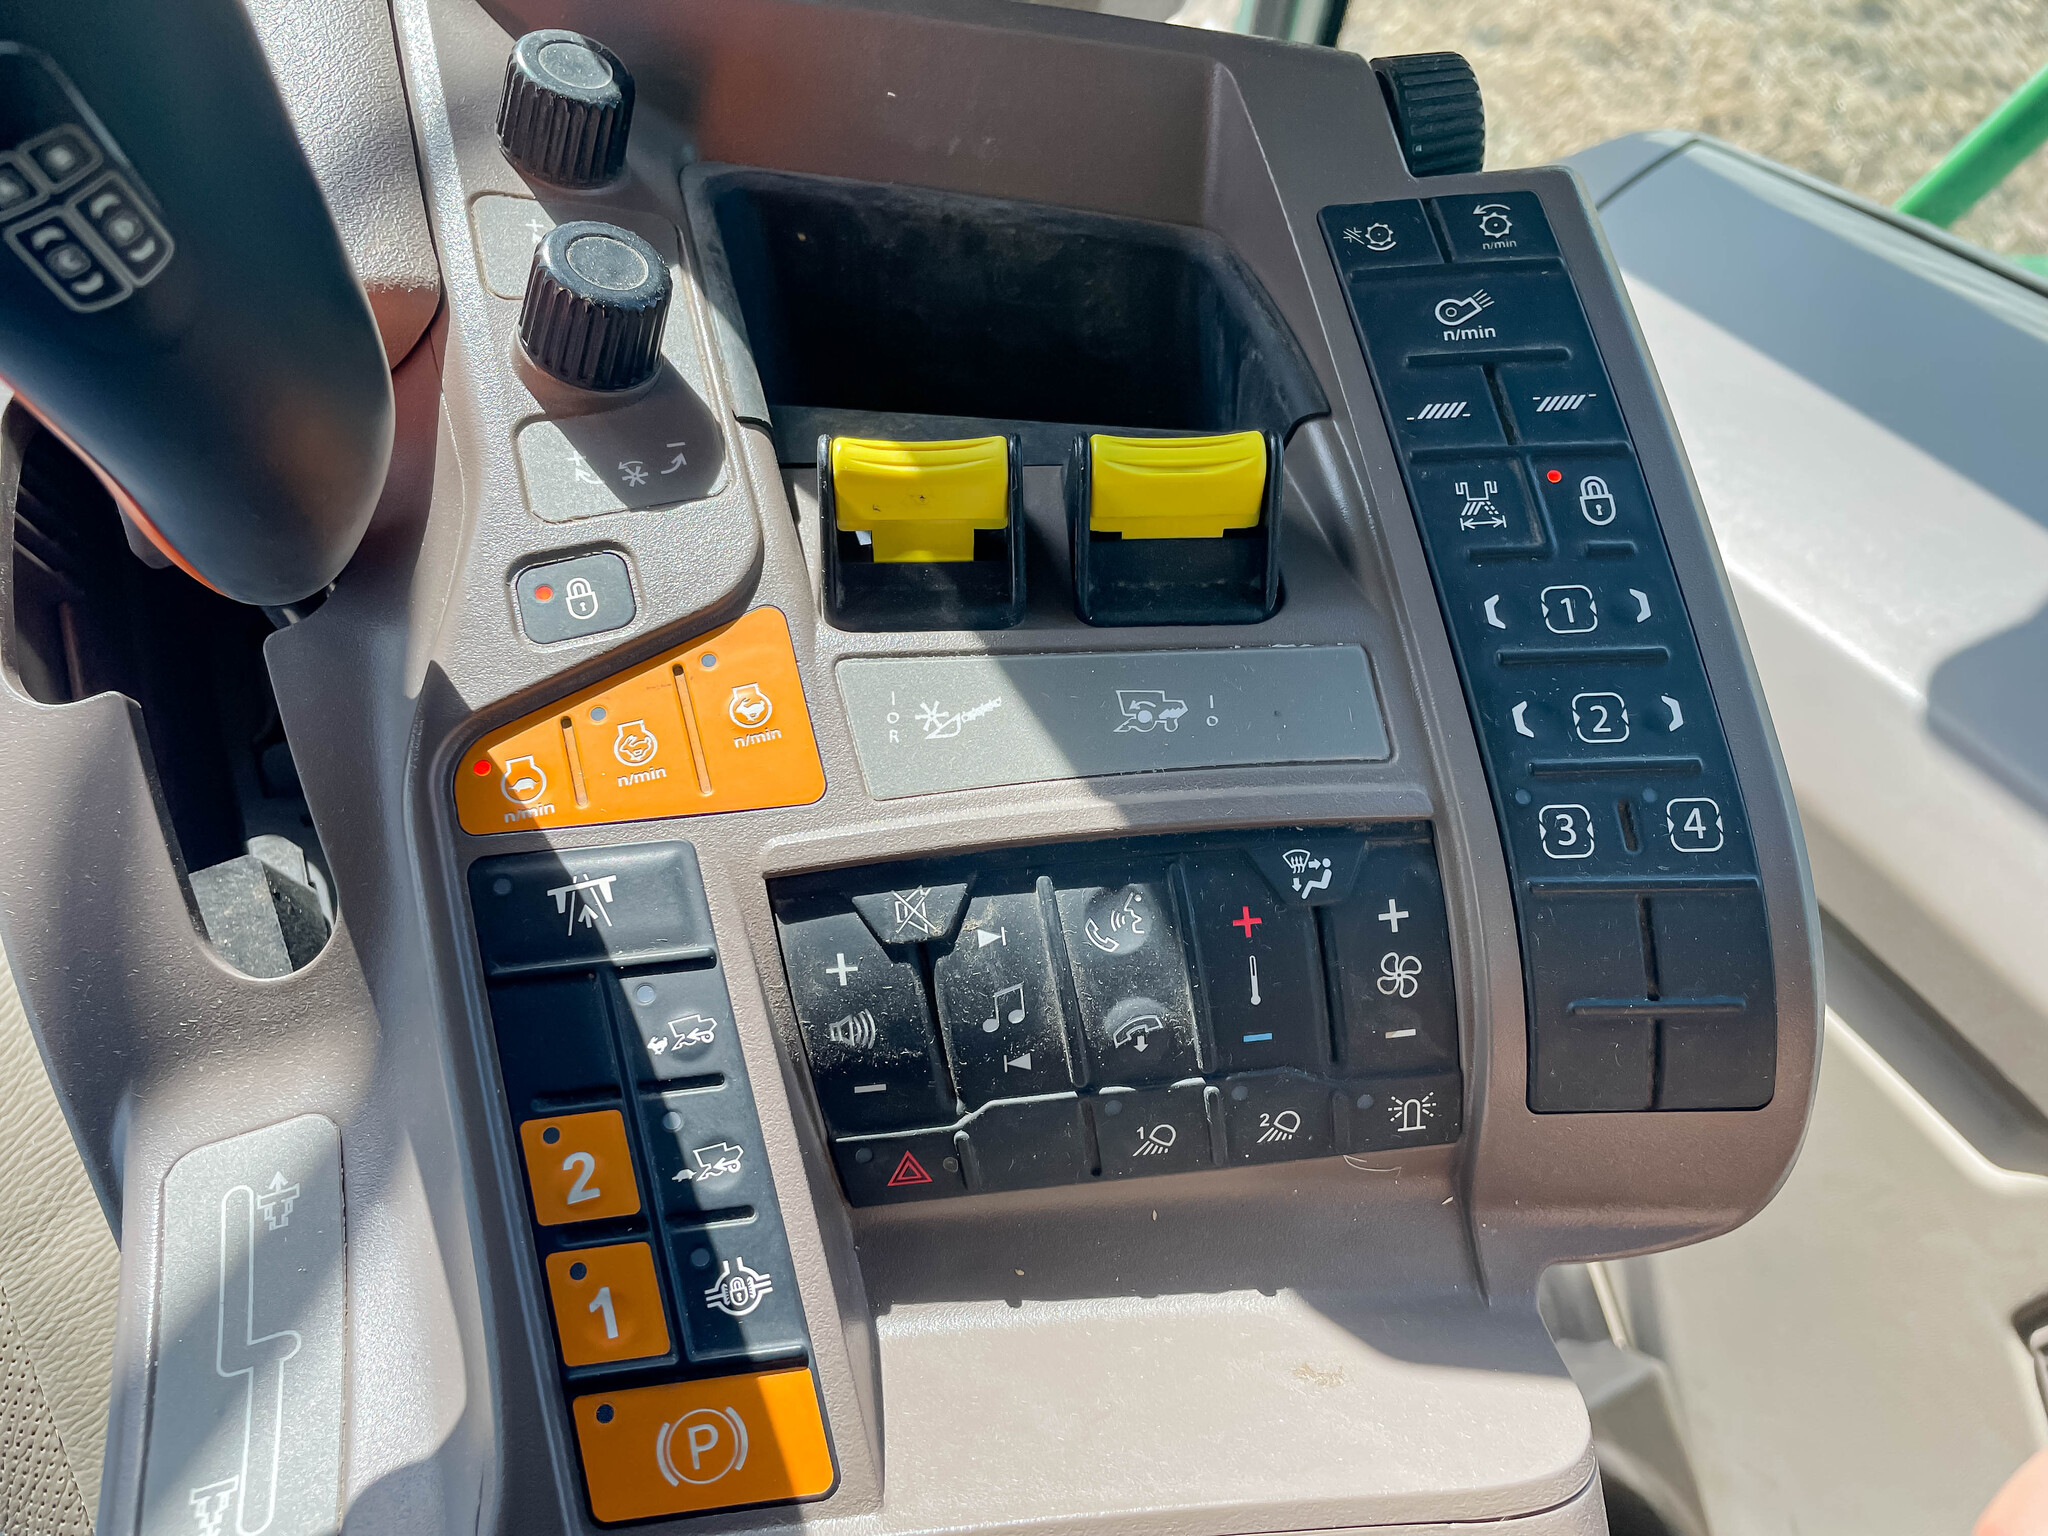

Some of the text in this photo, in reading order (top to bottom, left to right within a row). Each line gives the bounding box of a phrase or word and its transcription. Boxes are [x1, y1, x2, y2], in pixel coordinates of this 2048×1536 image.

[1482, 239, 1517, 250] n/min
[1443, 325, 1496, 341] n/min
[1560, 597, 1575, 623] 1
[1589, 705, 1612, 732] 2
[733, 727, 782, 748] n/min
[889, 729, 900, 743] R
[617, 766, 667, 787] n/min
[504, 802, 556, 823] n/min
[1683, 807, 1706, 839] 4
[1555, 813, 1577, 846] 3
[1259, 1113, 1270, 1127] 2
[1136, 1126, 1145, 1140] 1
[562, 1151, 600, 1205] 2
[588, 1286, 619, 1339] 1
[687, 1422, 719, 1470] P
